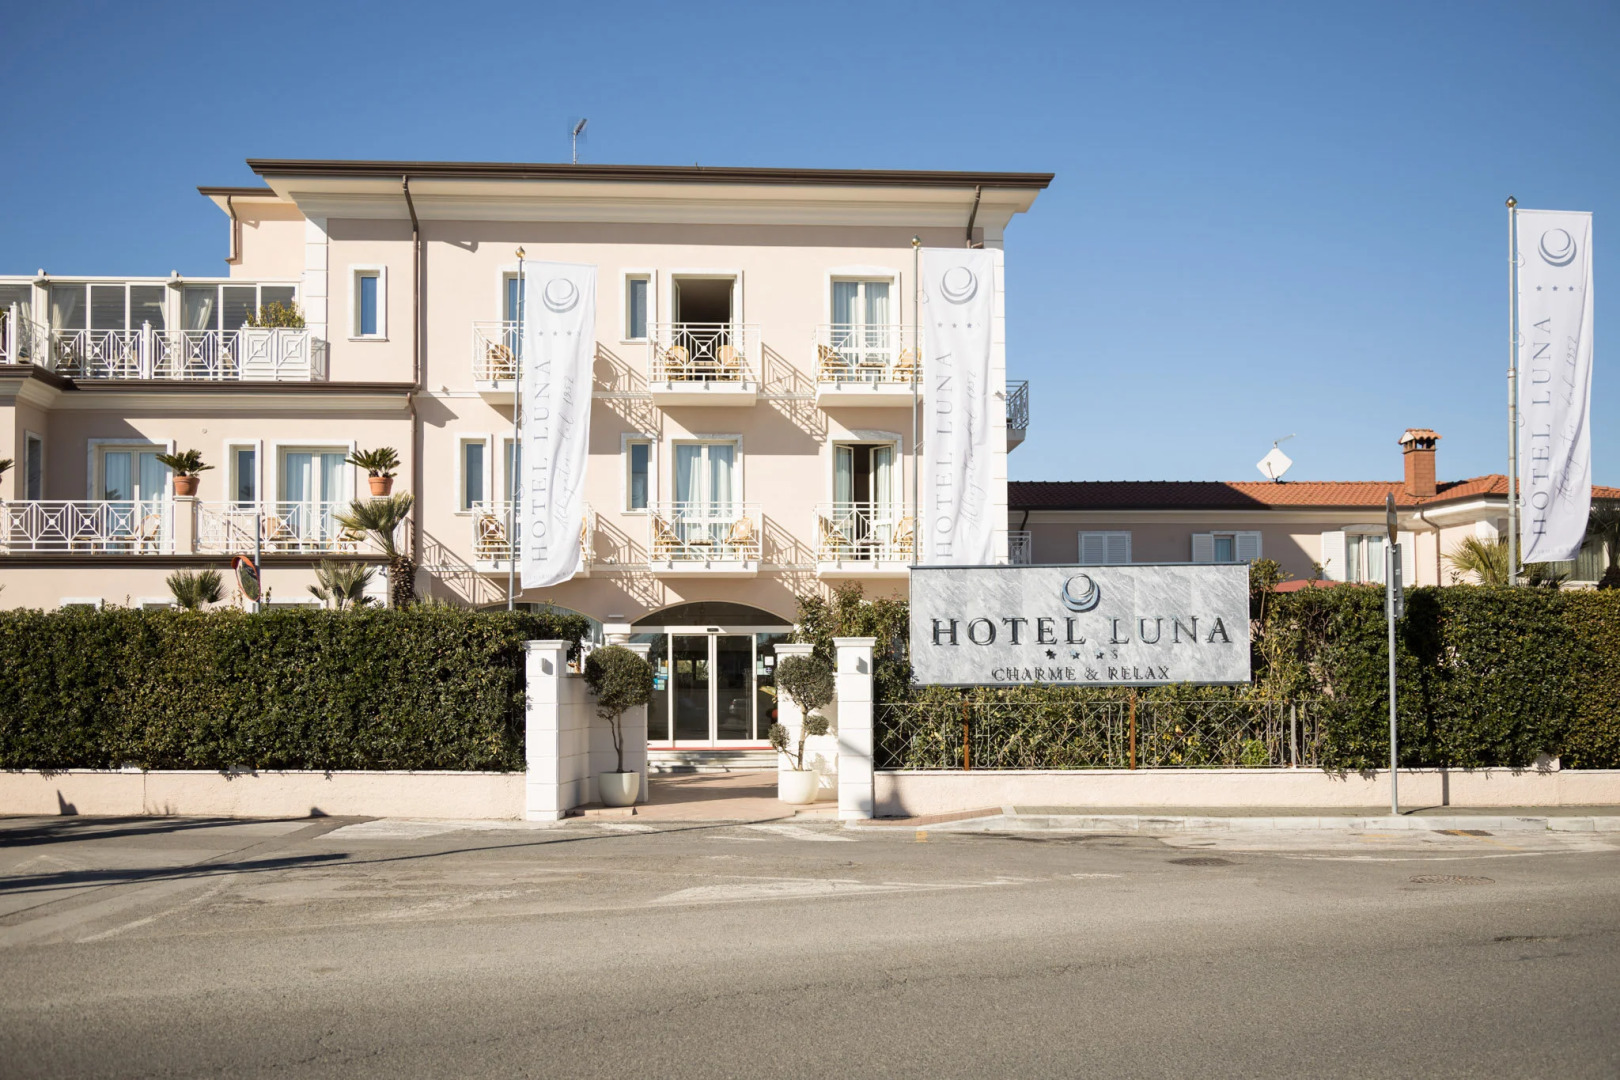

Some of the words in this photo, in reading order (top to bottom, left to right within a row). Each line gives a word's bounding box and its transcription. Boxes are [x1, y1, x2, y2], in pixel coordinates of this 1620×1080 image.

[534, 360, 550, 440] LUNA
[936, 352, 952, 435] LUNA
[1532, 316, 1551, 407] LUNA
[532, 457, 548, 562] HOTEL
[936, 453, 952, 557] HOTEL
[1531, 424, 1550, 536] HOTEL
[931, 616, 1087, 646] HOTEL
[1109, 615, 1233, 645] LUNA
[991, 666, 1077, 681] CHARME
[1084, 666, 1100, 681] &
[1107, 665, 1171, 681] RELAX
